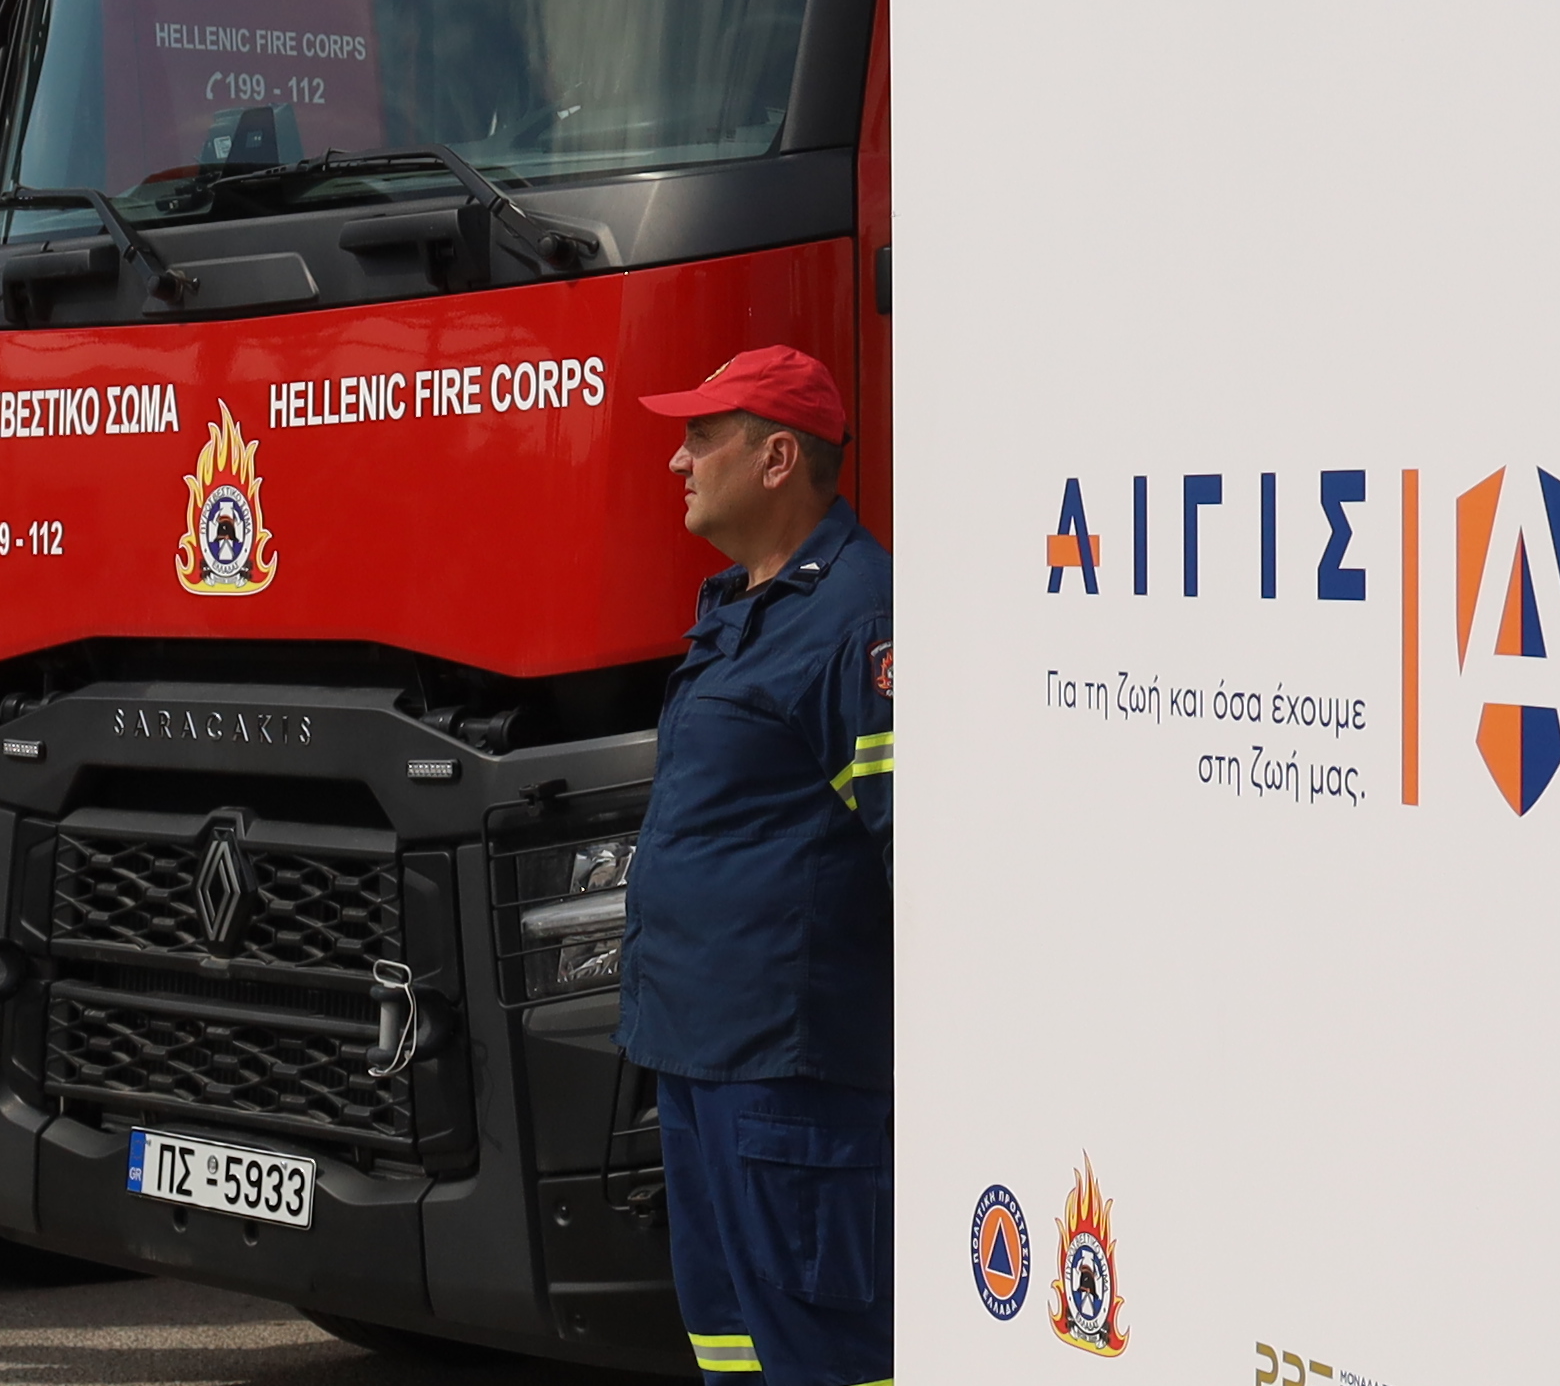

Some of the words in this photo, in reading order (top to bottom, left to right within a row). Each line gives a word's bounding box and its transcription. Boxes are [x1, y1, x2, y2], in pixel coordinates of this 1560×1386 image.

[155, 22, 250, 53] HELLENIC
[256, 30, 298, 56] FIRE
[302, 33, 367, 61] CORPS
[225, 72, 265, 101] 199
[288, 76, 325, 104] 112
[105, 383, 180, 436] ΣΩΜΑ
[268, 371, 408, 431] HELLENIC
[414, 364, 483, 419] FIRE
[490, 355, 606, 413] CORPS
[29, 520, 64, 557] 112
[1046, 469, 1366, 602] ΑΙΓΙΣ
[113, 708, 312, 746] SARACAKIS
[1046, 669, 1078, 711] Για
[1084, 678, 1109, 722] τη
[1117, 671, 1162, 725] ζωή
[1170, 683, 1205, 719] και
[1212, 679, 1262, 724] όσα
[1271, 681, 1367, 739] έχουμε
[1198, 750, 1241, 797] στη
[1250, 745, 1301, 802] ζωή
[1309, 761, 1366, 808] μας.
[129, 1166, 142, 1182] GR
[972, 1190, 996, 1264] ΠΟΛΙΤΙΚΗ
[998, 1190, 1029, 1279] ΠΡΟΣΤΑΣΙΑ
[982, 1288, 1018, 1316] ΕΛΛΑΔΑ
